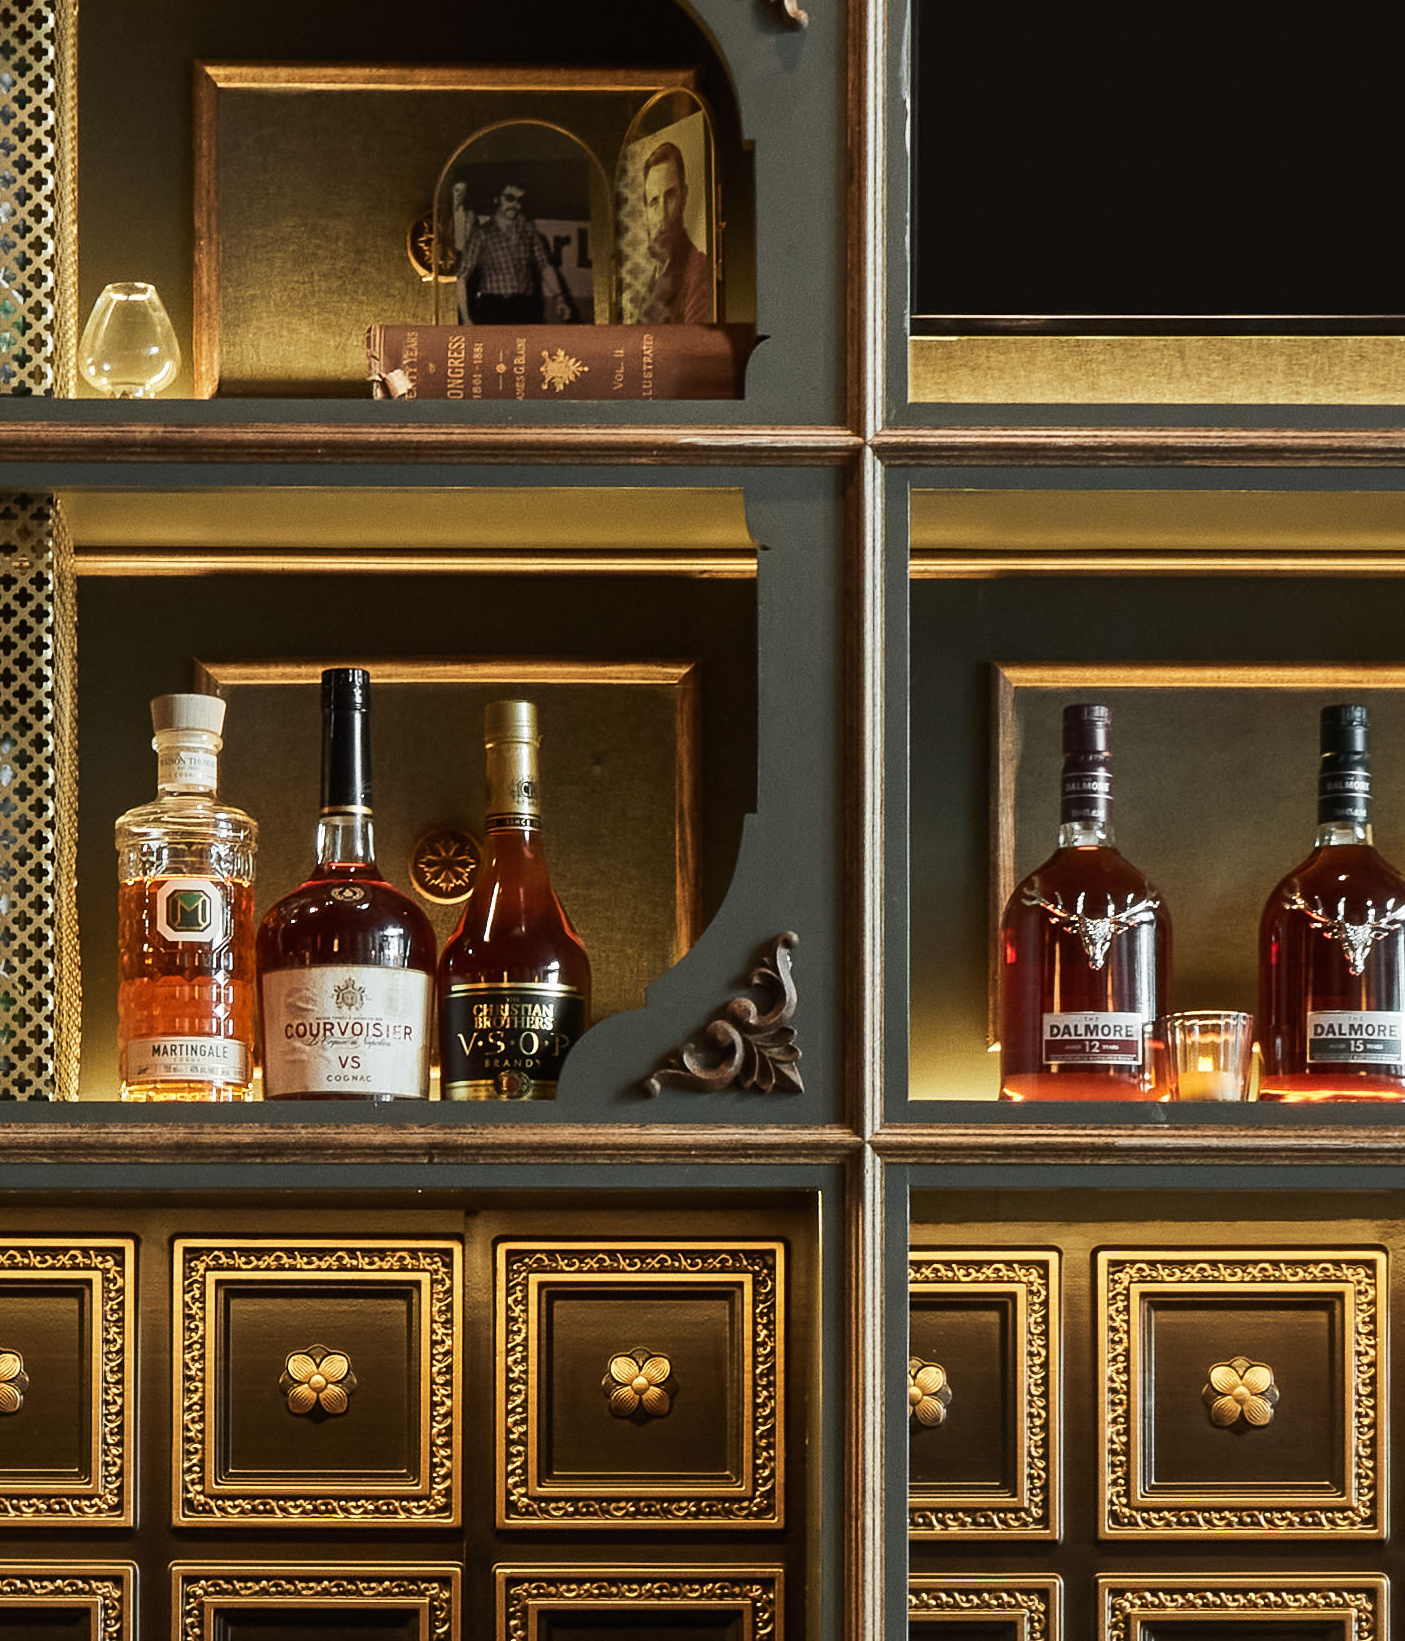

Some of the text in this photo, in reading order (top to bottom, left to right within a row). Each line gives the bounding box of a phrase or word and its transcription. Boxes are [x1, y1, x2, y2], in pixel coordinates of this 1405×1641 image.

[447, 335, 466, 399] ONGRESS
[1065, 782, 1110, 792] DALMORE
[1327, 781, 1370, 791] DALMORE
[473, 1004, 554, 1017] CHRISTIAN
[474, 1017, 554, 1030] BROTHERS
[285, 1021, 413, 1041] COURVOISIER
[1049, 1024, 1134, 1038] DALMORE
[1313, 1024, 1397, 1036] DALMORE
[152, 1044, 228, 1058] MARTINGALE
[1084, 1041, 1100, 1052] 12
[1349, 1040, 1364, 1052] 15
[338, 1056, 361, 1069] VS
[484, 1059, 542, 1068] BRANDY
[326, 1074, 372, 1083] COGNAC
